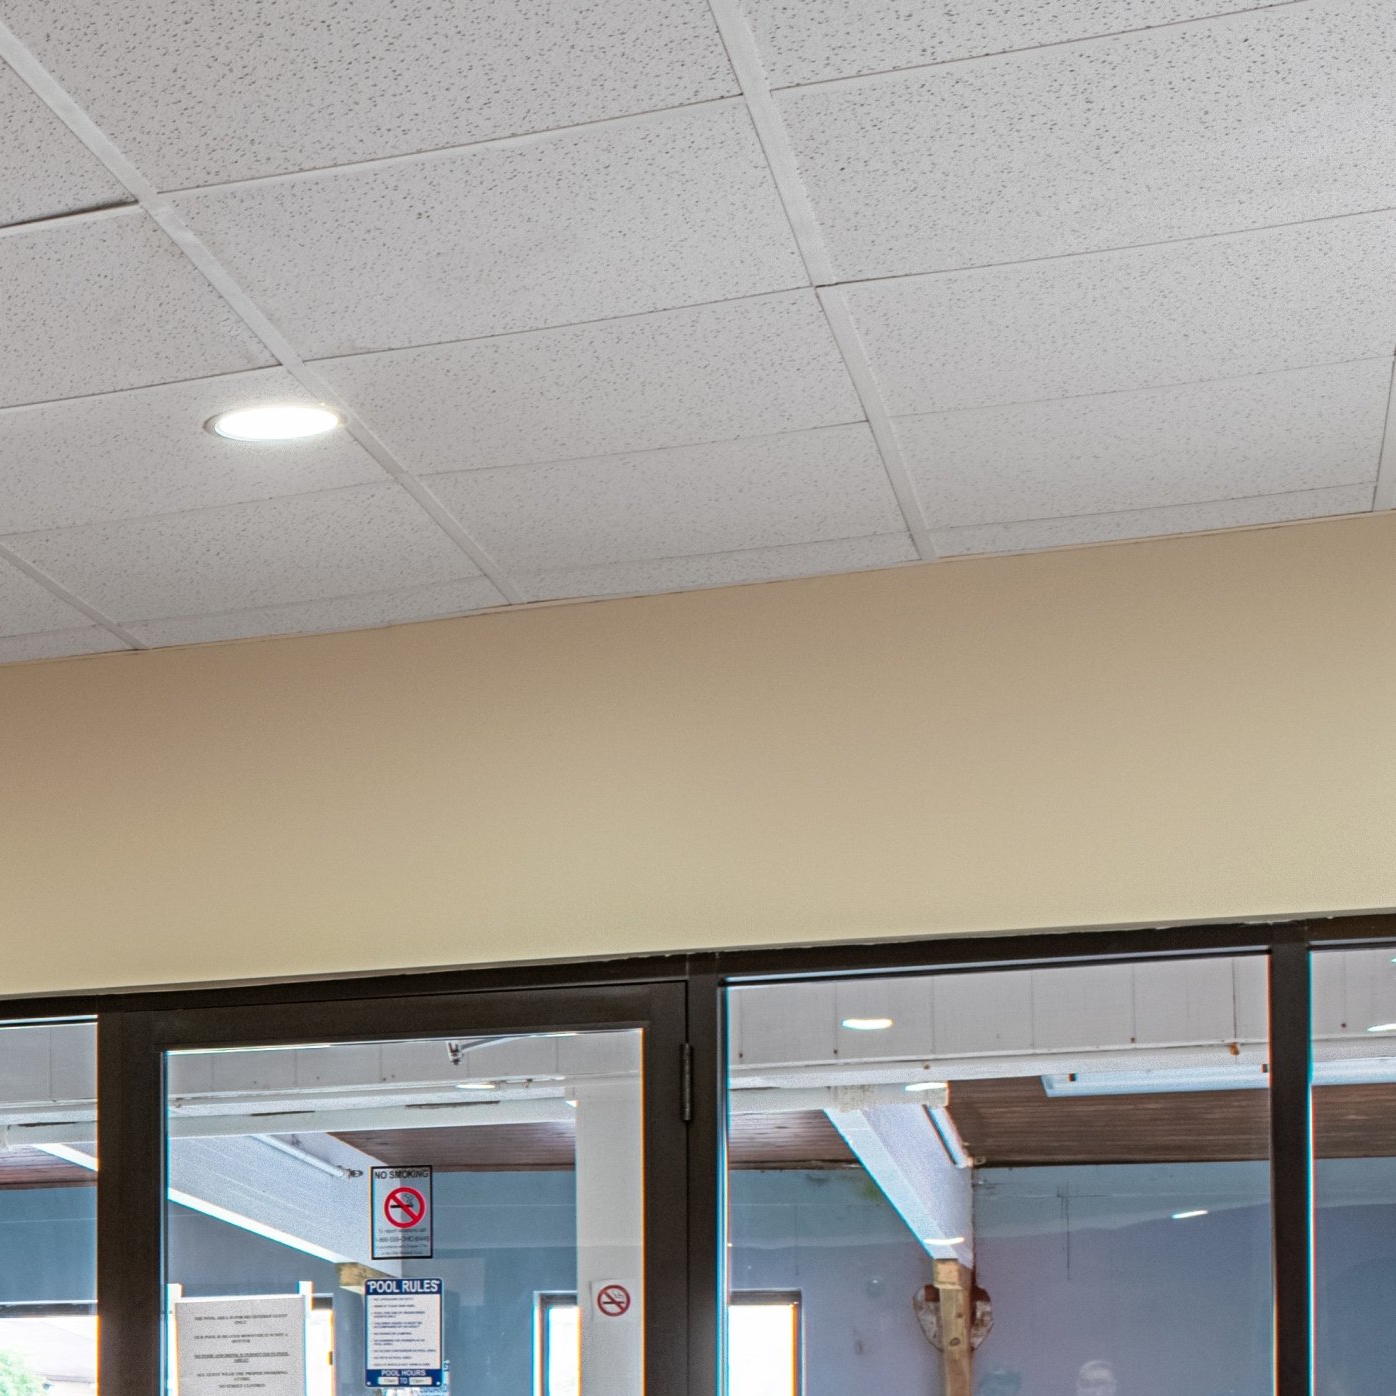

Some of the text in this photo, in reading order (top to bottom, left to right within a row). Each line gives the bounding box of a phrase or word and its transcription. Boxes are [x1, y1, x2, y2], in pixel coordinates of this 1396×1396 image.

[375, 1169, 428, 1179] NO SMOKING
[370, 1280, 438, 1292] POOL RULES
